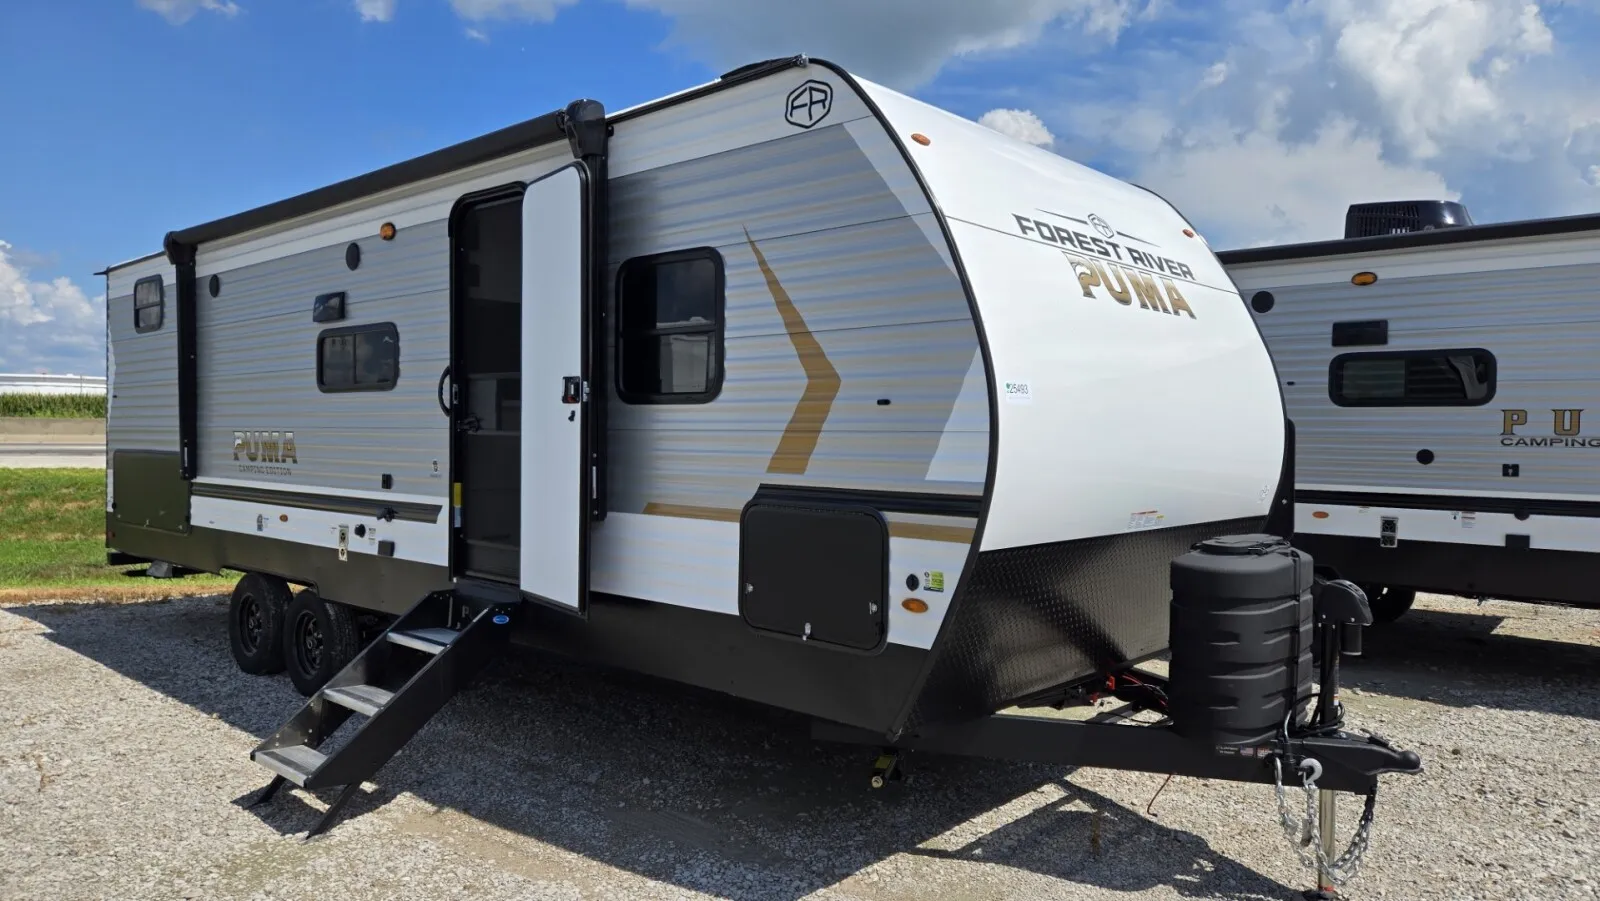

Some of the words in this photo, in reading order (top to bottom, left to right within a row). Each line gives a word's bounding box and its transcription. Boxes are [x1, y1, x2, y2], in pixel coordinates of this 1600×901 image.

[1011, 213, 1122, 260] FOREST
[1124, 246, 1196, 281] RIVER
[1061, 250, 1197, 320] PUMA
[232, 430, 298, 464] PUMA
[1500, 438, 1600, 447] CAMPING
